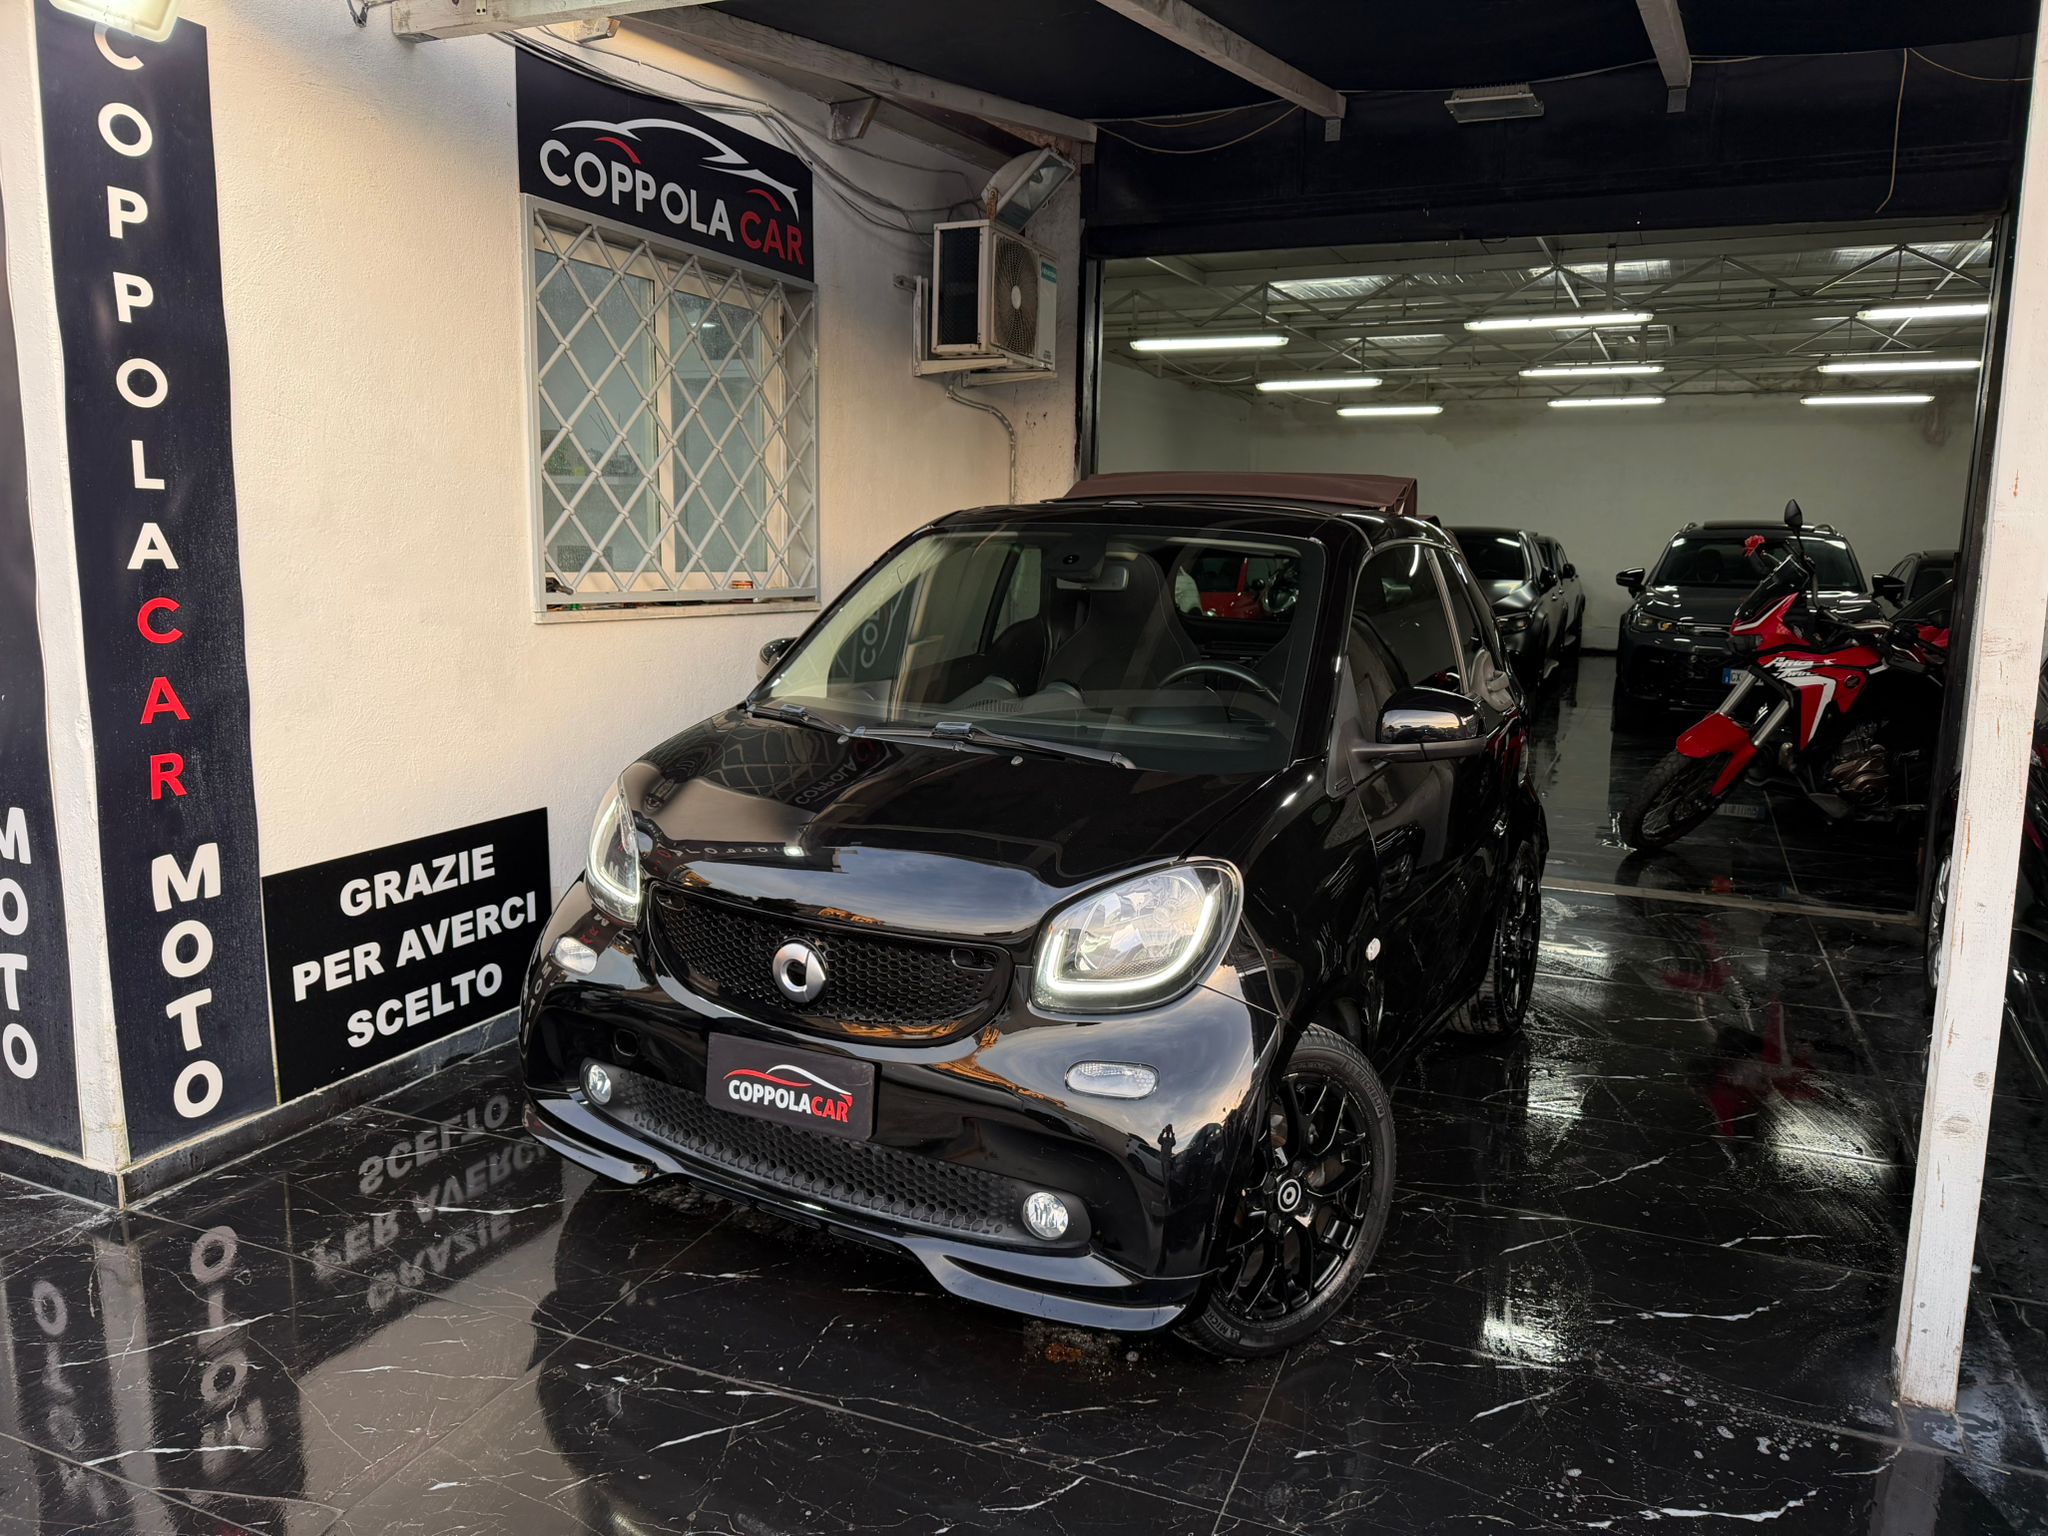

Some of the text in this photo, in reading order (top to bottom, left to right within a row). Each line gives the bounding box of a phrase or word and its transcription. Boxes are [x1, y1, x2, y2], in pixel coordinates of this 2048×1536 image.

[340, 844, 496, 917] GRAZIE
[151, 842, 223, 1119] MOTO
[292, 941, 384, 1003] PER
[396, 890, 537, 968] AVERCI
[346, 963, 503, 1049] SCELTO
